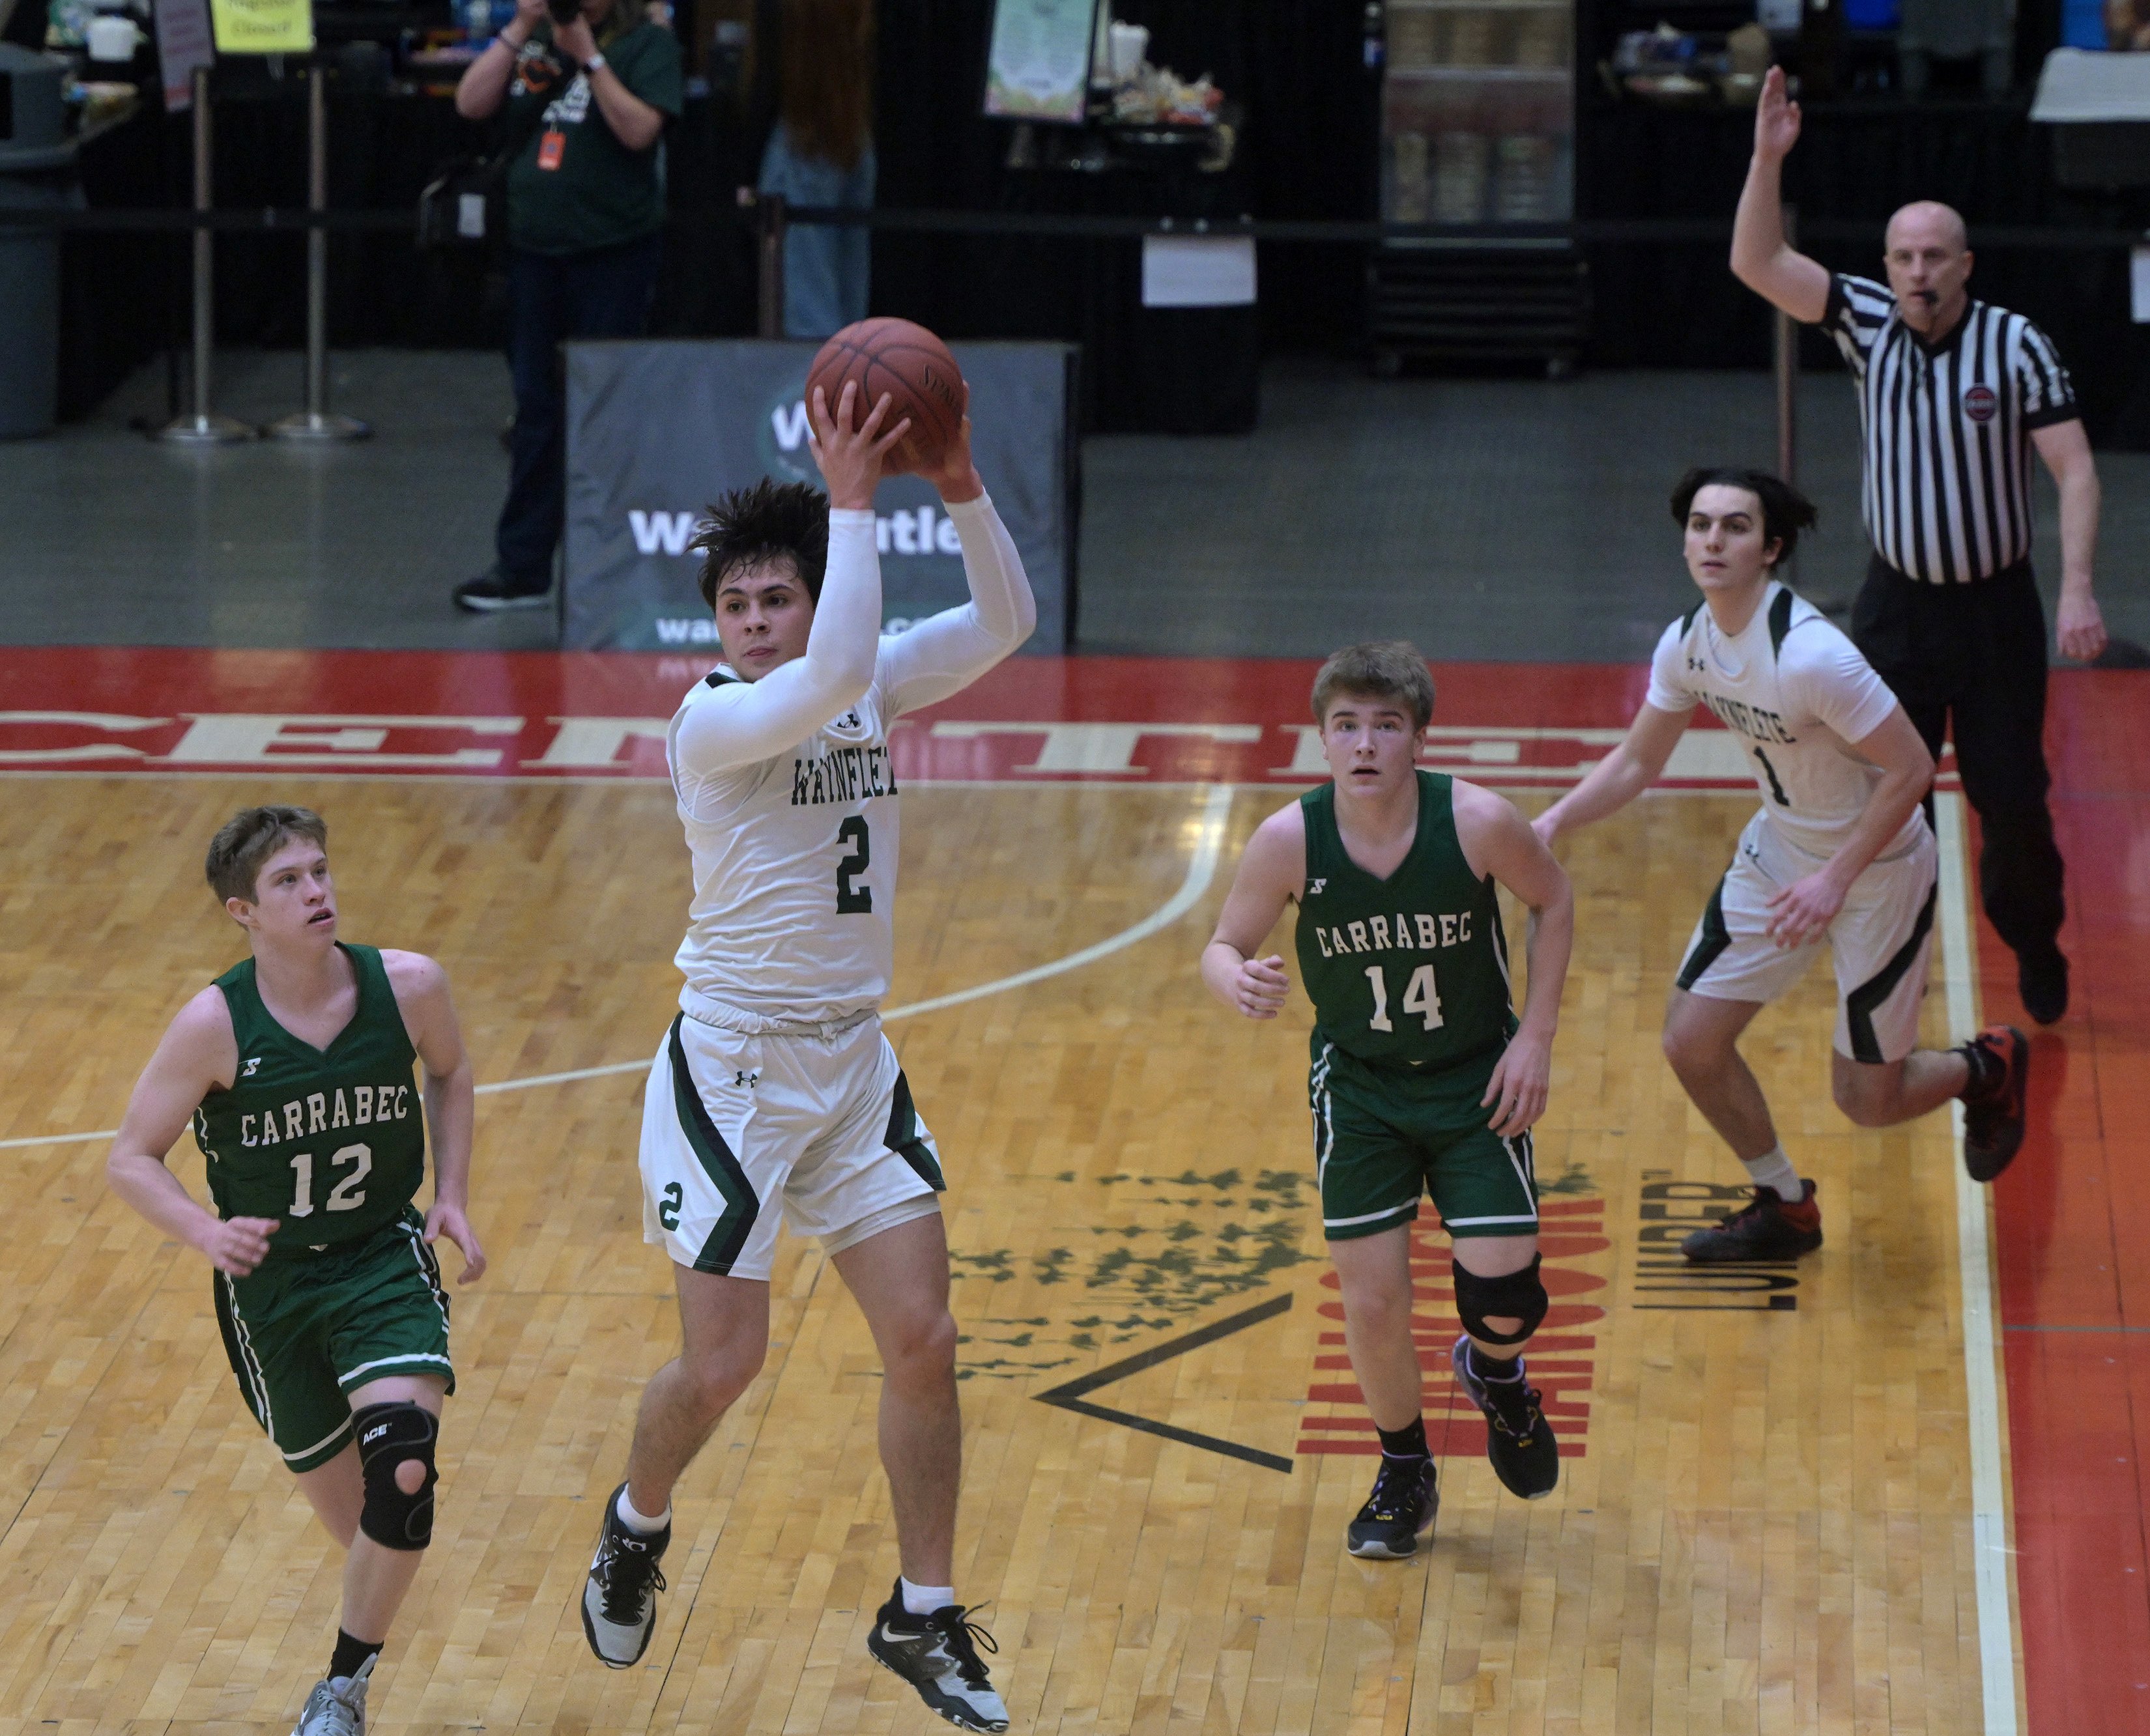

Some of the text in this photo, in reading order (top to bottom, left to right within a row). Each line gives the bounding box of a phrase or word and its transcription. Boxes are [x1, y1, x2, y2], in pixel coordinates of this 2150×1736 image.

[1753, 746, 1790, 806] 1
[836, 815, 872, 915] 2
[1315, 911, 1472, 958] CARRABEC
[1365, 964, 1444, 1032] 14
[240, 1085, 408, 1147] CARRABEC
[289, 1143, 372, 1218] 12
[659, 1182, 683, 1231] 2
